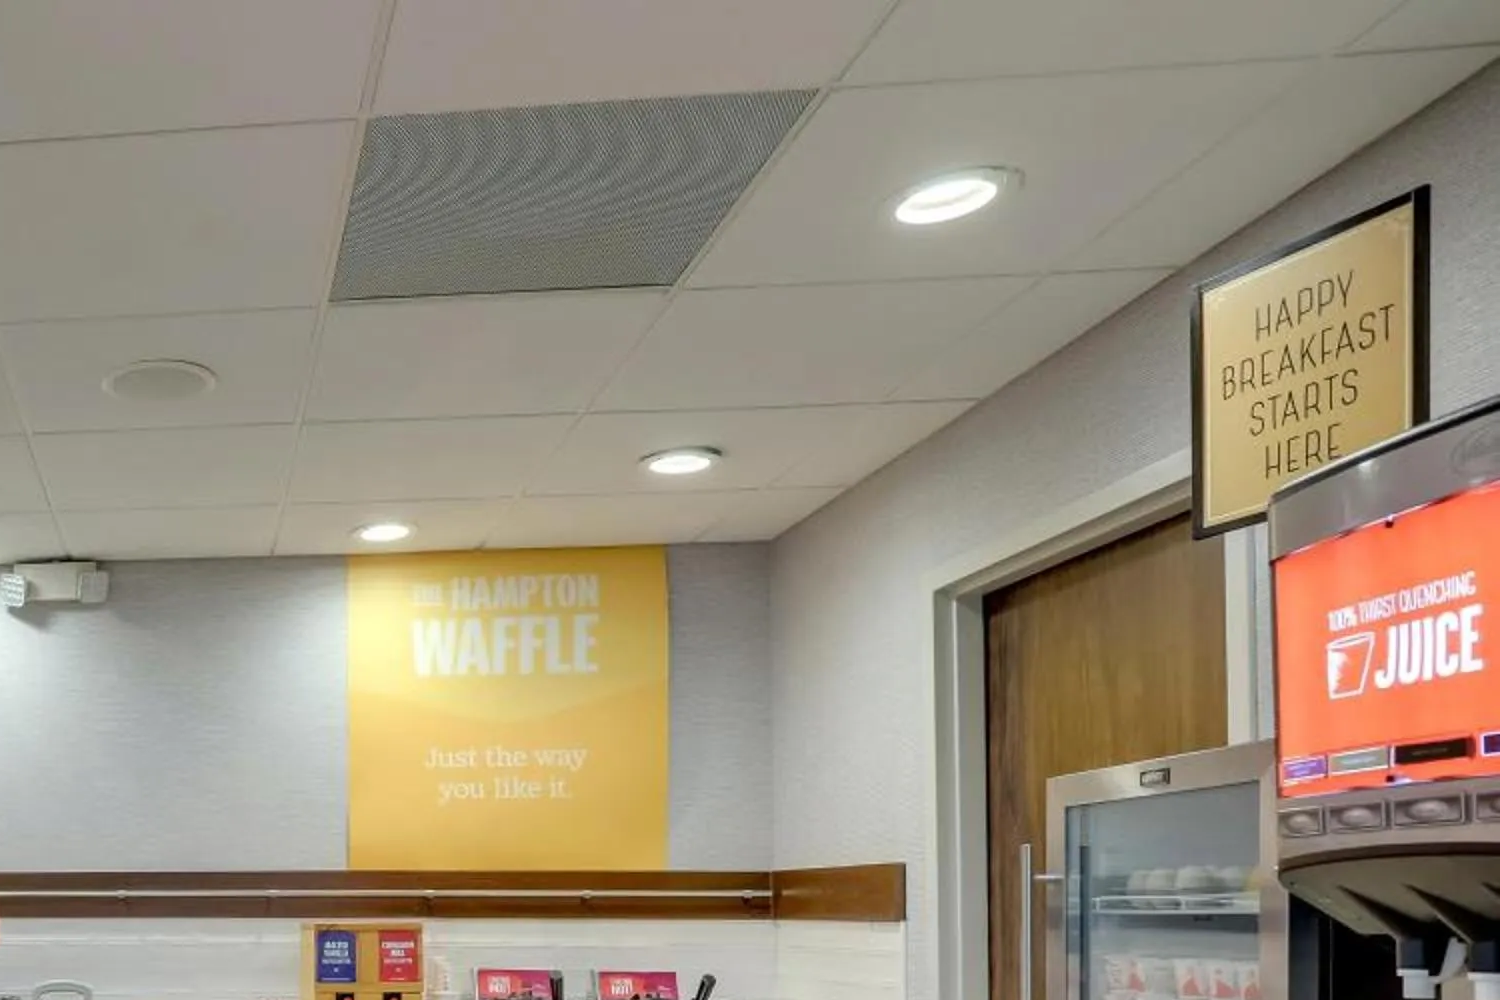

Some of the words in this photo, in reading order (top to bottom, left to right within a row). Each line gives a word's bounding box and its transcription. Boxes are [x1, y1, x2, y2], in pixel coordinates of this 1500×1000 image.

[1254, 269, 1355, 342] HAPPY
[1222, 303, 1396, 401] BREAKFAST
[1249, 369, 1359, 437] STARTS
[1264, 423, 1344, 480] HERE
[451, 575, 599, 611] HAMPTON
[1399, 570, 1477, 614] QUENCHING
[411, 614, 599, 677] WAFFLE
[1374, 603, 1485, 690] JUICE
[425, 745, 478, 771] Just
[485, 745, 529, 768] the
[533, 748, 588, 772] way
[437, 780, 485, 808] you
[493, 775, 543, 800] like
